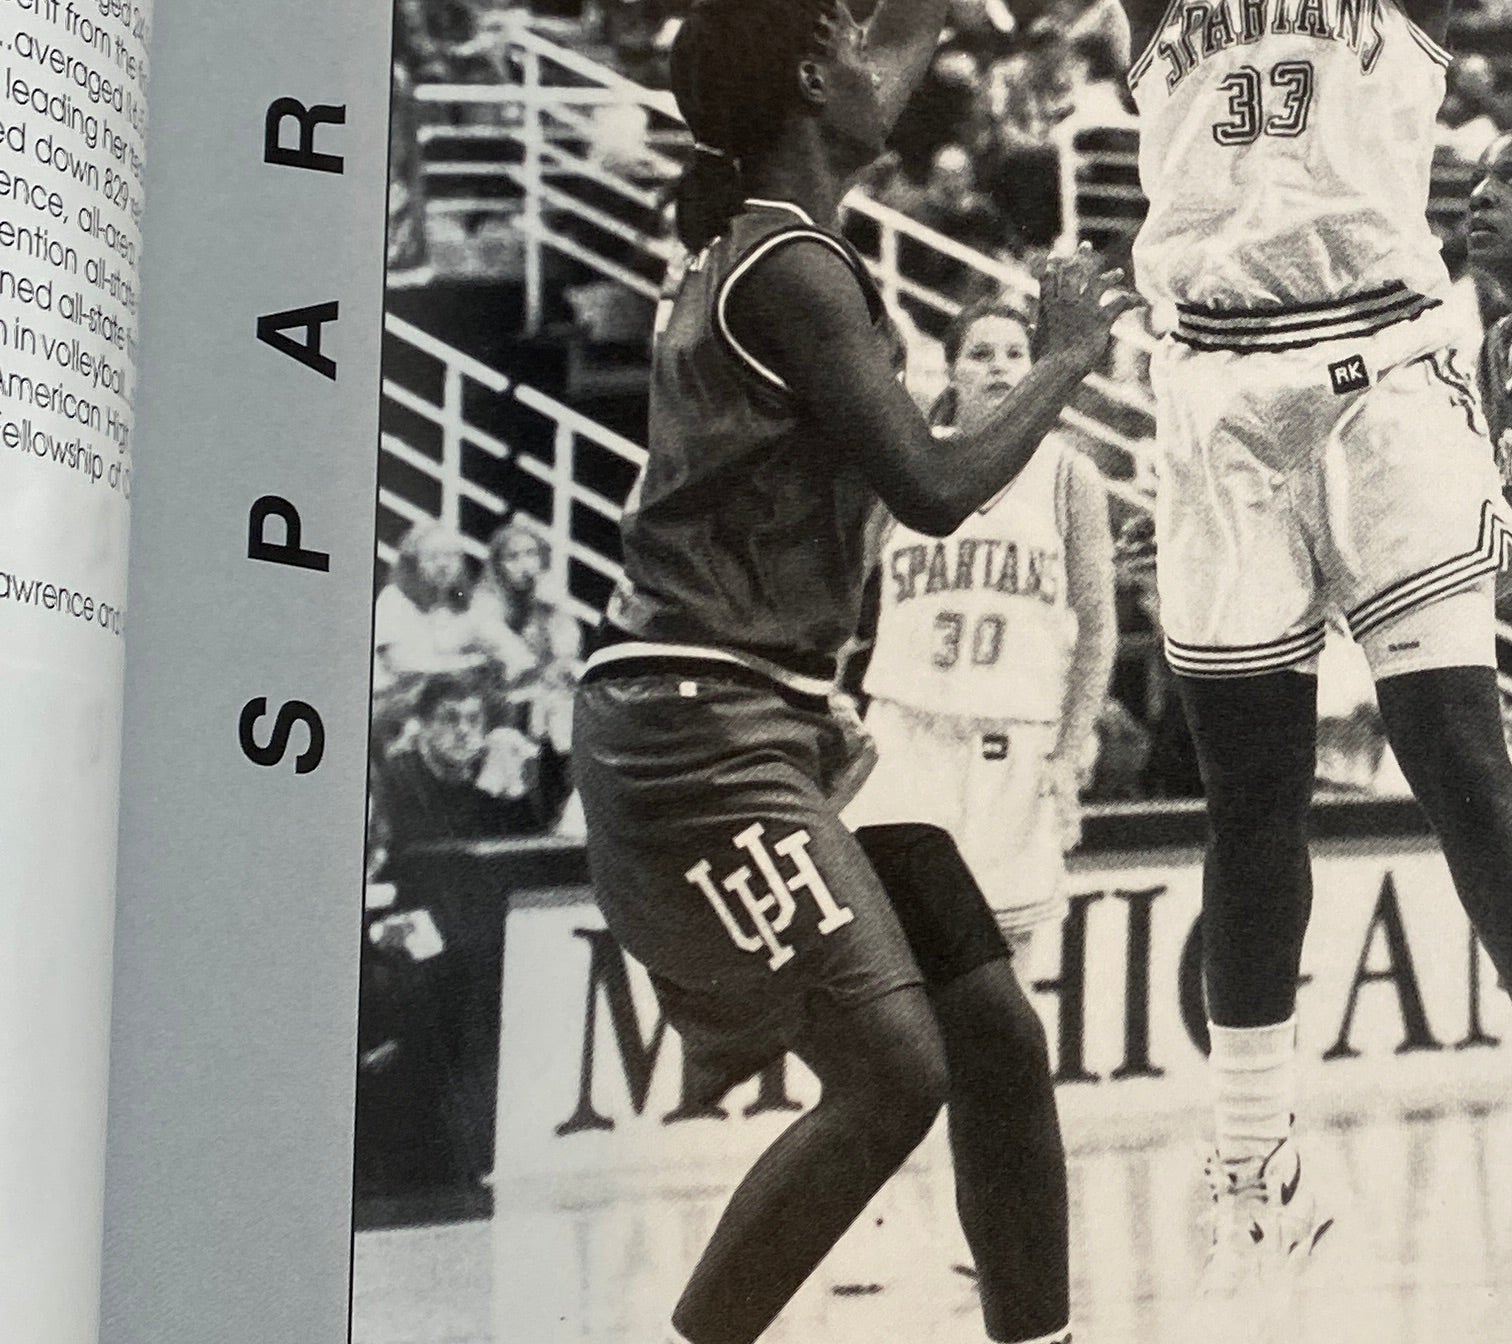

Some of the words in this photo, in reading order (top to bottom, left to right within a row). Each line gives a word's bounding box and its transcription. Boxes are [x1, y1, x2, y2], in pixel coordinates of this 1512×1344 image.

[66, 2, 111, 59] from
[7, 67, 98, 150] leading
[1213, 60, 1315, 146] 33
[35, 134, 100, 193] down
[14, 316, 37, 356] in
[932, 611, 1007, 671] 30
